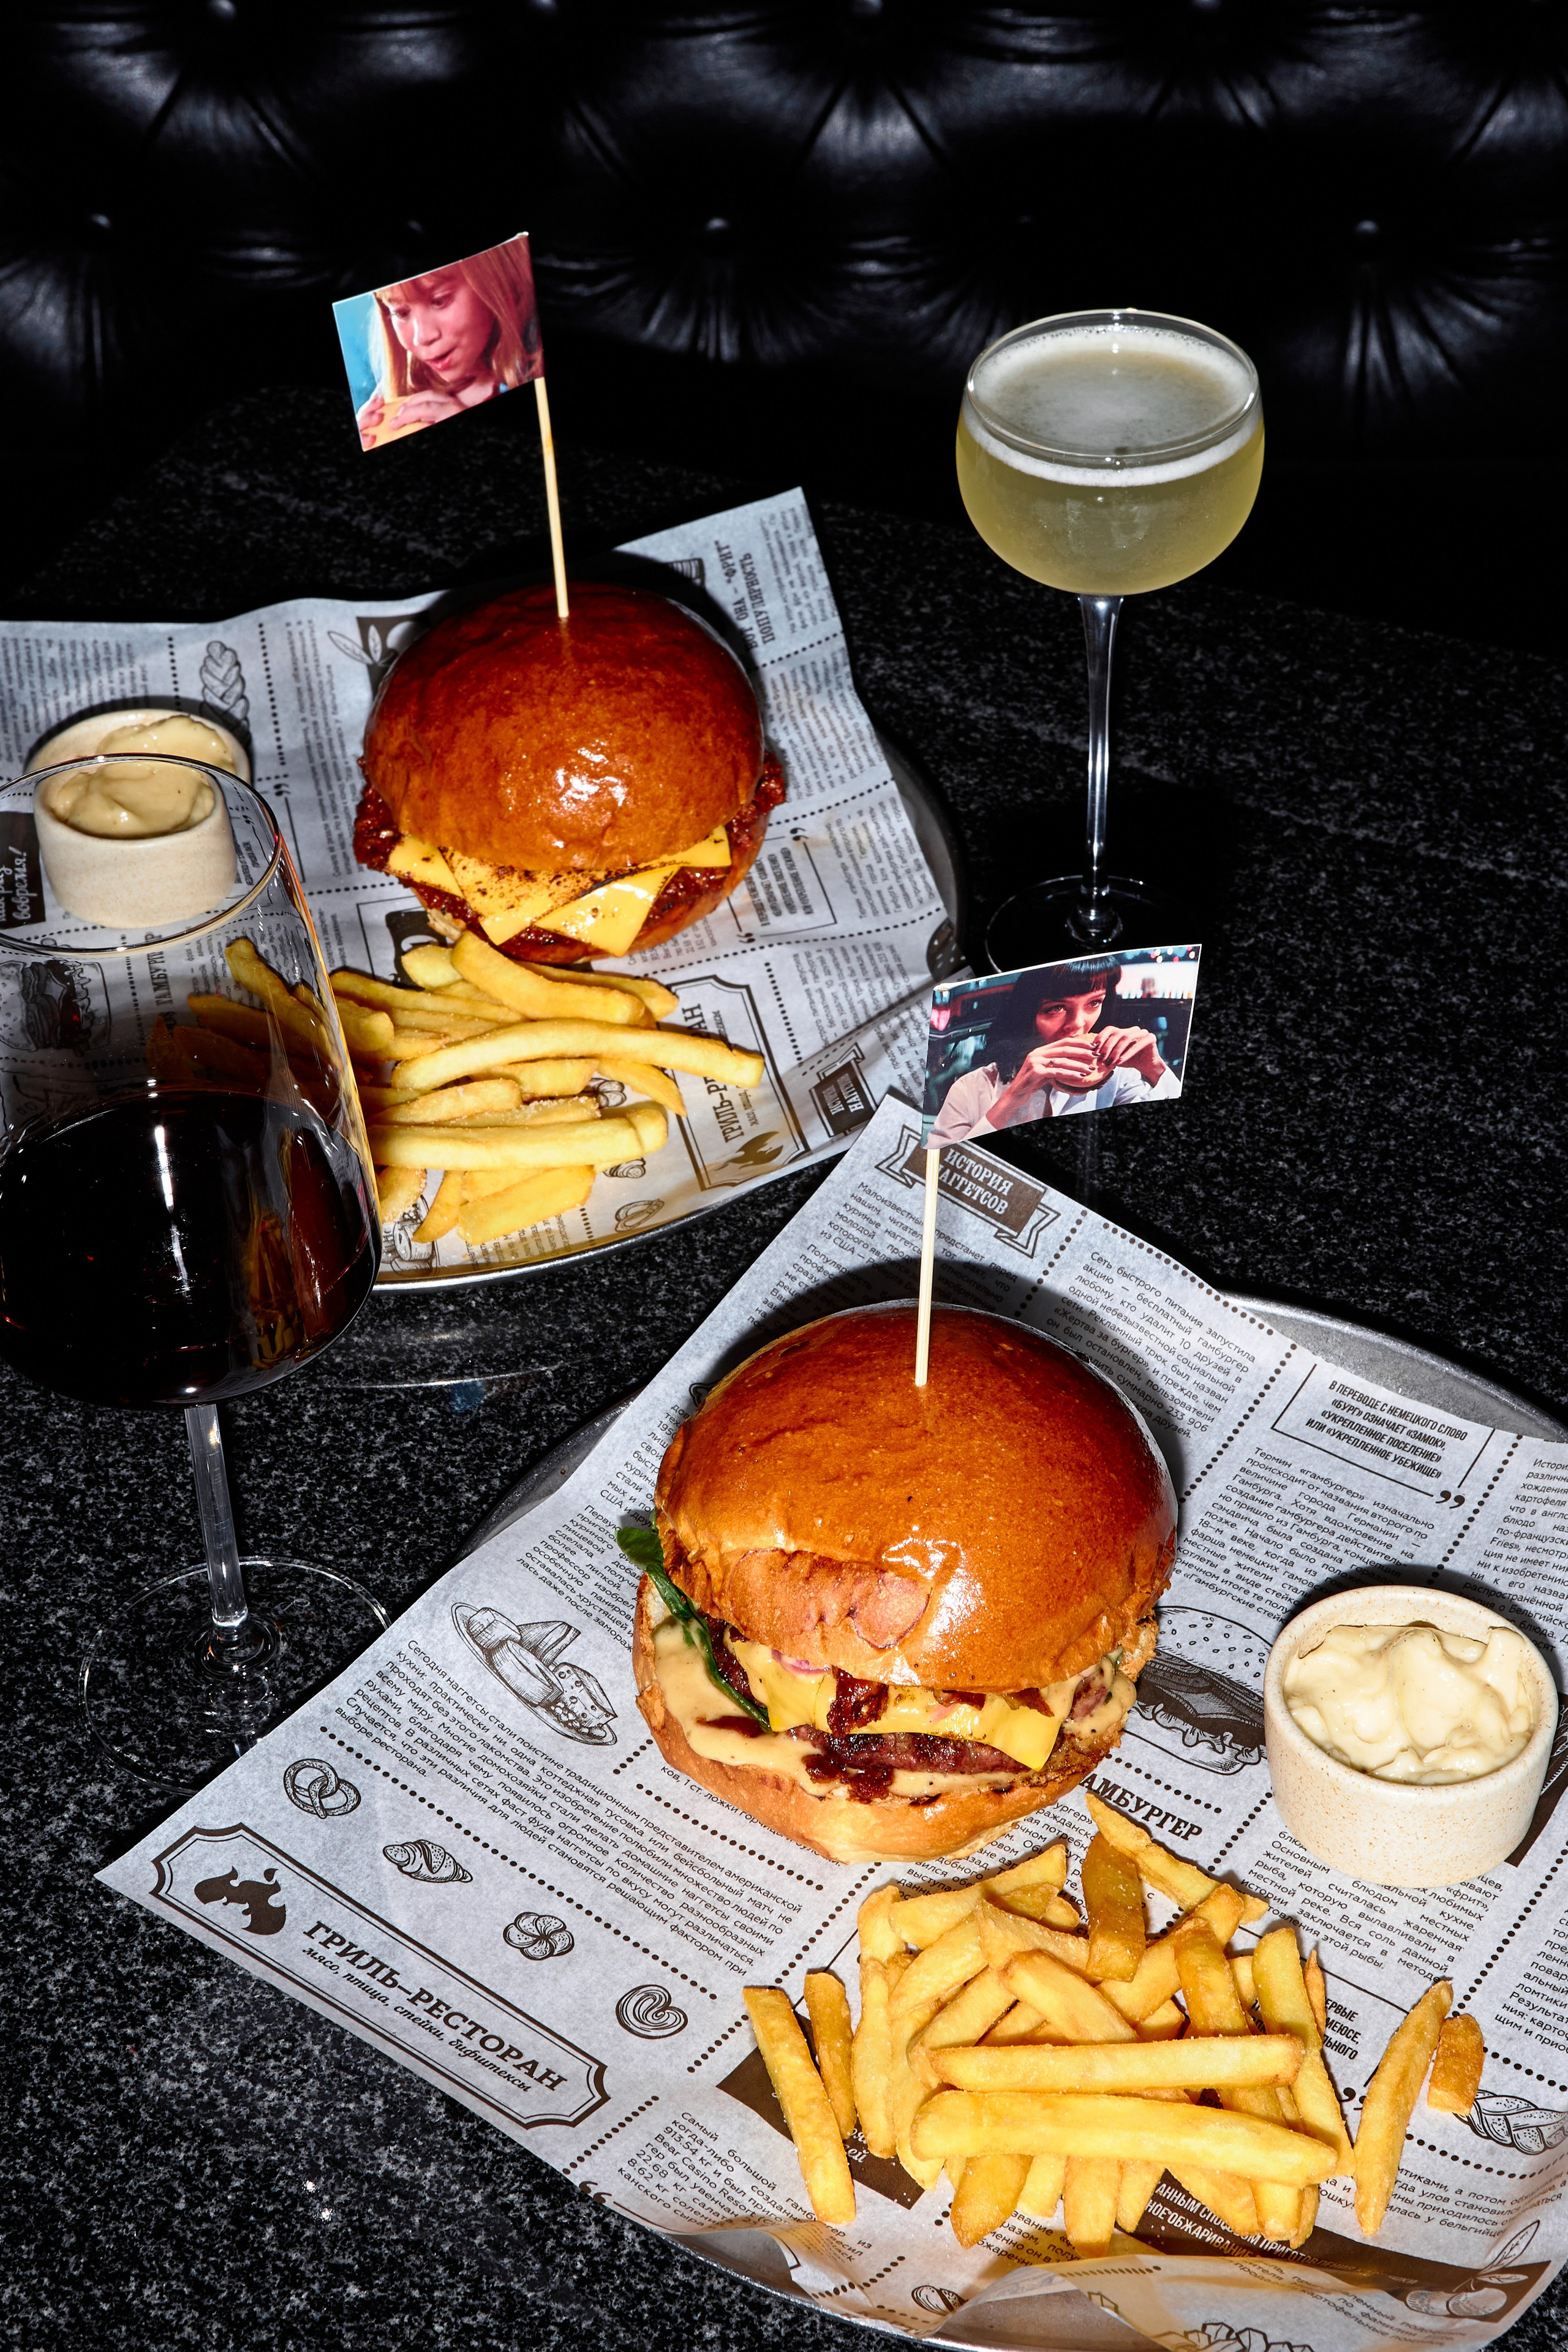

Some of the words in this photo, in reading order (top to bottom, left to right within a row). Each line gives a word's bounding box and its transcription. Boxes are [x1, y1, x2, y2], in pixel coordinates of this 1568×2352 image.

[732, 598, 748, 620] ОНА
[739, 553, 775, 644] ПОПУЛЯРНОСТЬ
[944, 1148, 1013, 1196] ИСТОРИЯ
[820, 1229, 832, 1240] из
[832, 1237, 854, 1254] США
[827, 1220, 869, 1249] которого
[835, 1211, 876, 1239] молодой
[842, 1202, 881, 1229] куриные
[1068, 1286, 1099, 1306] одной
[1099, 1303, 1176, 1355] небезызвестной
[1176, 1354, 1235, 1393] социальной
[1074, 1275, 1114, 1301] любому,
[1119, 1298, 1136, 1312] кто
[1139, 1312, 1175, 1338] удалит
[1179, 1338, 1191, 1349] 10
[1193, 1351, 1231, 1376] друзей
[1082, 1264, 1114, 1284] акцию
[1136, 1292, 1192, 1335] бесплатный
[1197, 1336, 1248, 1373] гамбургер
[1090, 1251, 1112, 1269] Сеть
[1116, 1266, 1161, 1297] быстрого
[1164, 1297, 1203, 1328] питания
[1205, 1327, 1255, 1363] запустила
[1321, 1409, 1388, 1443] «УКРЕПЛЕННОЕ
[1385, 1436, 1442, 1463] ПОСЕЛЕНИЕ»
[1328, 1379, 1338, 1390] В
[1335, 1383, 1381, 1409] ПЕРЕВОДЕ
[1379, 1402, 1388, 1412] С
[1385, 1404, 1438, 1430] НЕМЕЦКОГО
[1436, 1423, 1468, 1441] СЛОВО
[1331, 1398, 1363, 1417] «БУРГ»
[1362, 1411, 1408, 1434] ОЗНАЧАЕТ
[1405, 1428, 1446, 1451] «ЗАМОК»,
[1305, 1417, 1327, 1432] ИЛИ
[1325, 1427, 1393, 1460] «УКРЕПЛЕННОЕ
[1390, 1453, 1442, 1479] УБЕЖИЩЕ»
[1238, 1466, 1287, 1490] величине
[1298, 1491, 1336, 1512] города
[1347, 1512, 1399, 1540] Германии
[1245, 1457, 1307, 1486] происходит
[1307, 1483, 1321, 1492] от
[1320, 1489, 1370, 1515] названия
[1370, 1511, 1413, 1533] второго
[1413, 1530, 1428, 1539] по
[1254, 1446, 1292, 1468] Термин
[1300, 1468, 1364, 1500] «гамбургер»
[1372, 1500, 1434, 1529] изначально
[1509, 1505, 1526, 1513] что
[1514, 1494, 1567, 1507] картофеля
[555, 1529, 594, 1558] сделала
[562, 1523, 606, 1554] пищевой
[569, 1518, 613, 1550] куриного
[1489, 1536, 1520, 1551] Fries»,
[1502, 1515, 1535, 1528] блюдо
[525, 1551, 576, 1594] оставалась
[576, 1593, 628, 1630] хрустящей
[532, 1546, 583, 1586] особенную
[540, 1540, 590, 1580] профессор
[594, 1581, 635, 1610] изобрел
[548, 1534, 576, 1556] более
[585, 1563, 621, 1591] липкой.
[375, 1670, 405, 1696] всему
[407, 1698, 434, 1722] миру.
[437, 1722, 476, 1753] Многие
[477, 1754, 547, 1801] домохозяйки
[549, 1801, 581, 1823] стали
[581, 1823, 619, 1849] делать
[621, 1849, 678, 1887] домашние
[681, 1887, 730, 1920] наггетсы
[733, 1920, 774, 1945] своими
[385, 1660, 432, 1702] проходят
[431, 1700, 450, 1717] без
[448, 1716, 477, 1738] этого
[476, 1738, 530, 1777] лакомства.
[532, 1774, 552, 1790] Это
[552, 1788, 619, 1833] изобретение
[618, 1831, 673, 1869] полюбили
[672, 1868, 731, 1905] множество
[730, 1904, 769, 1926] людей
[767, 1923, 783, 1934] по
[396, 1650, 427, 1679] кухни:
[429, 1681, 490, 1733] практически
[510, 1747, 536, 1766] одна
[540, 1766, 600, 1807] коттеджная
[604, 1807, 644, 1837] тусовка
[648, 1837, 669, 1852] или
[673, 1852, 745, 1898] бейсбольный
[747, 1896, 774, 1914] матч
[777, 1913, 792, 1924] не
[407, 1640, 447, 1678] Сегодня
[445, 1676, 489, 1716] наггетсы
[488, 1715, 517, 1738] стали
[516, 1736, 564, 1770] поистине
[564, 1767, 640, 1819] традиционным
[639, 1817, 725, 1872] представителем
[724, 1869, 802, 1913] американской
[1248, 1869, 1297, 1897] местной
[1300, 1897, 1330, 1916] реке.
[1339, 1913, 1362, 1930] Вся
[1368, 1930, 1395, 1946] соль
[1401, 1947, 1449, 1973] данной
[1254, 1860, 1286, 1880] рыба,
[1297, 1882, 1348, 1909] которую
[1357, 1911, 1436, 1953] вылавливали
[1262, 1850, 1311, 1879] жителей
[1328, 1883, 1385, 1914] считалась
[1403, 1919, 1464, 1952] жаренная
[1271, 1840, 1330, 1874] Основным
[1351, 1880, 1398, 1907] блюдом
[1419, 1913, 1470, 1942] местных
[1422, 1891, 1484, 1921] любимых
[1439, 1910, 1474, 1931] кухне.
[1446, 1887, 1489, 1912] «фрит»,
[301, 1947, 339, 1974] мясо,
[341, 1972, 390, 2007] птица,
[393, 2005, 445, 2041] стейки,
[448, 2038, 532, 2092] бифштексы
[654, 2133, 680, 2156] Bear
[681, 2156, 717, 2188] Casino
[718, 2187, 756, 2217] Resort
[663, 2126, 698, 2155] 913.54
[698, 2156, 712, 2166] кг
[712, 2169, 722, 2177] и
[723, 2177, 746, 2197] был
[671, 2119, 734, 2172] когда-либо
[681, 2112, 719, 2141] Самый
[727, 2149, 777, 2191] большой
[644, 2142, 665, 2160] гер
[667, 2161, 690, 2182] был
[689, 2182, 739, 2217] увенчан
